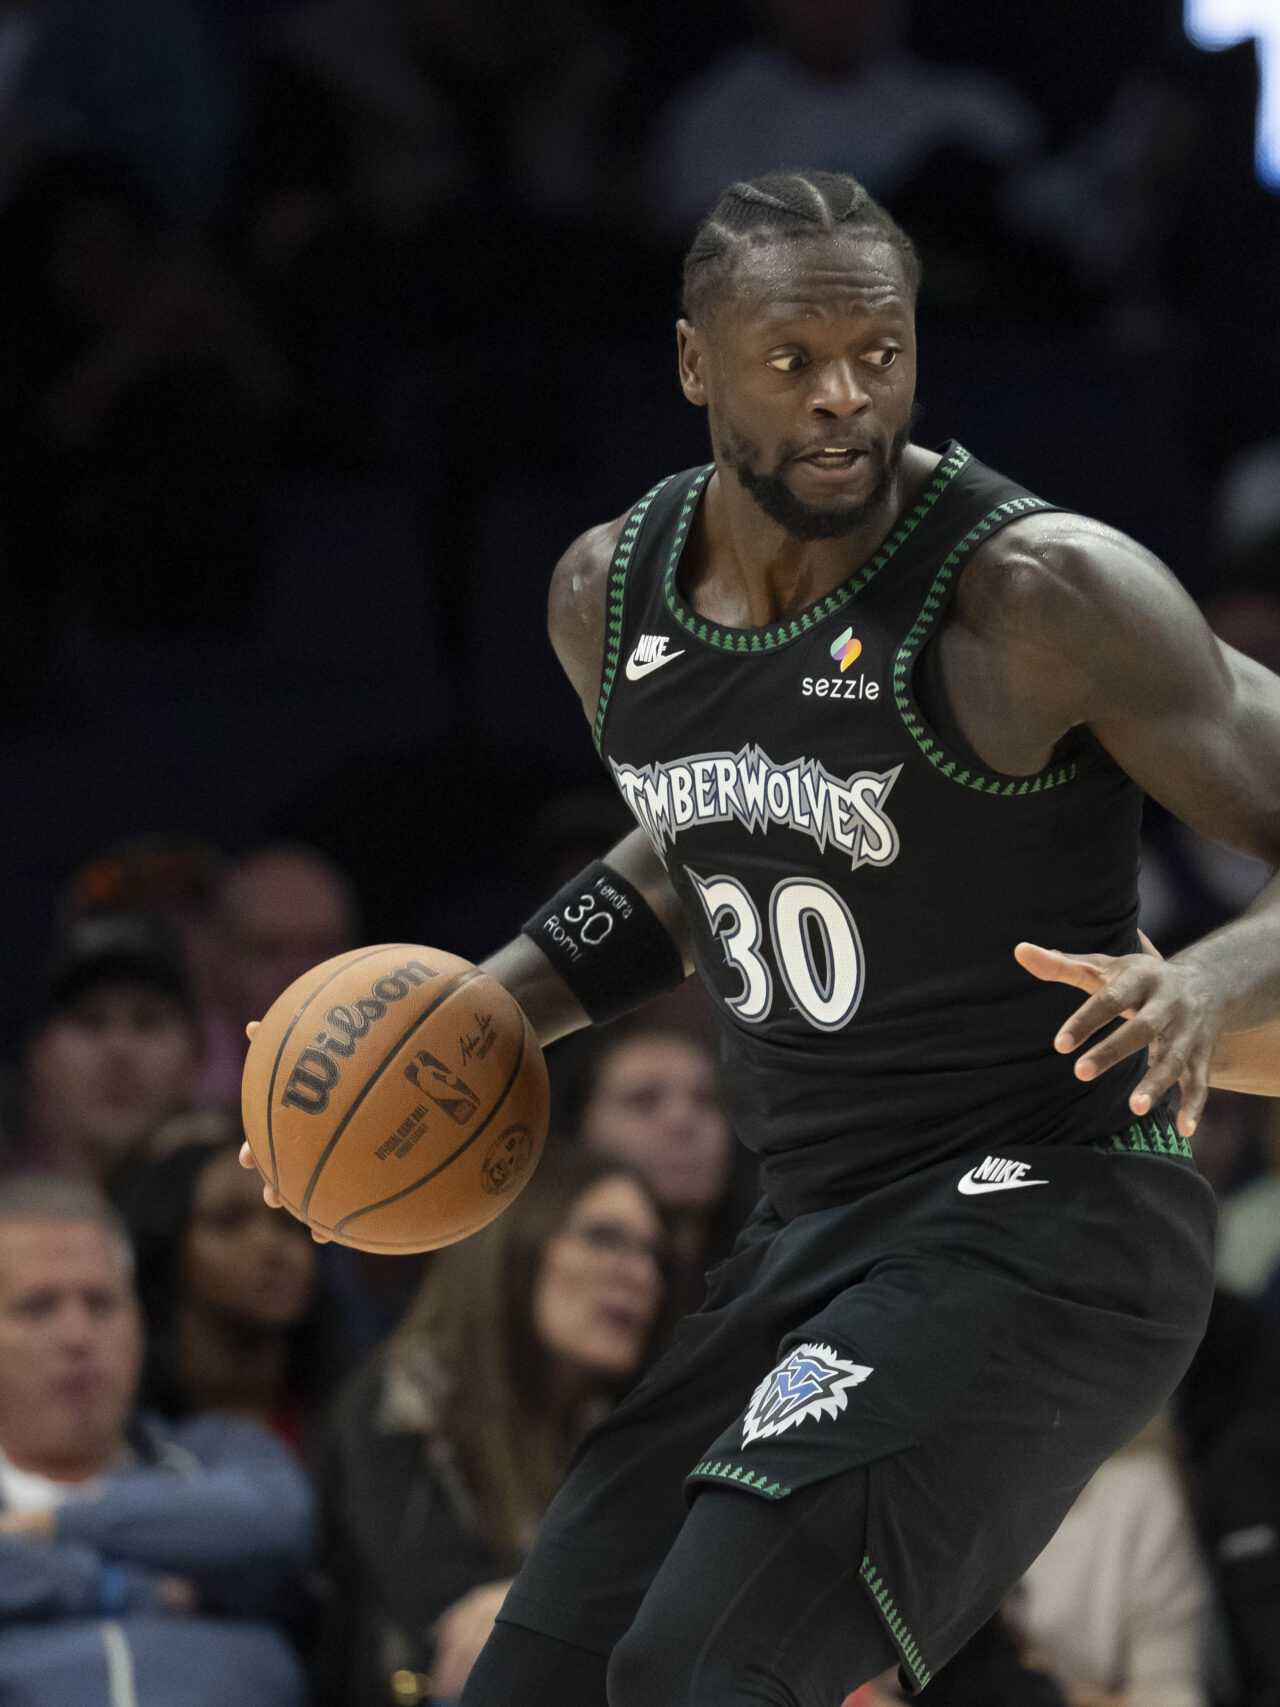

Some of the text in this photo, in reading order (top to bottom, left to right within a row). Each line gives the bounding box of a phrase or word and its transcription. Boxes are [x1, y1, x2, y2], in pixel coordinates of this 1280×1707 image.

[634, 634, 670, 663] NIKE
[801, 674, 880, 700] sezzle
[608, 743, 904, 872] TIMBERWOLVES
[564, 894, 613, 945] 30
[683, 864, 866, 1032] 30
[281, 960, 440, 1116] Wilson
[973, 1155, 1032, 1183] NIKE
